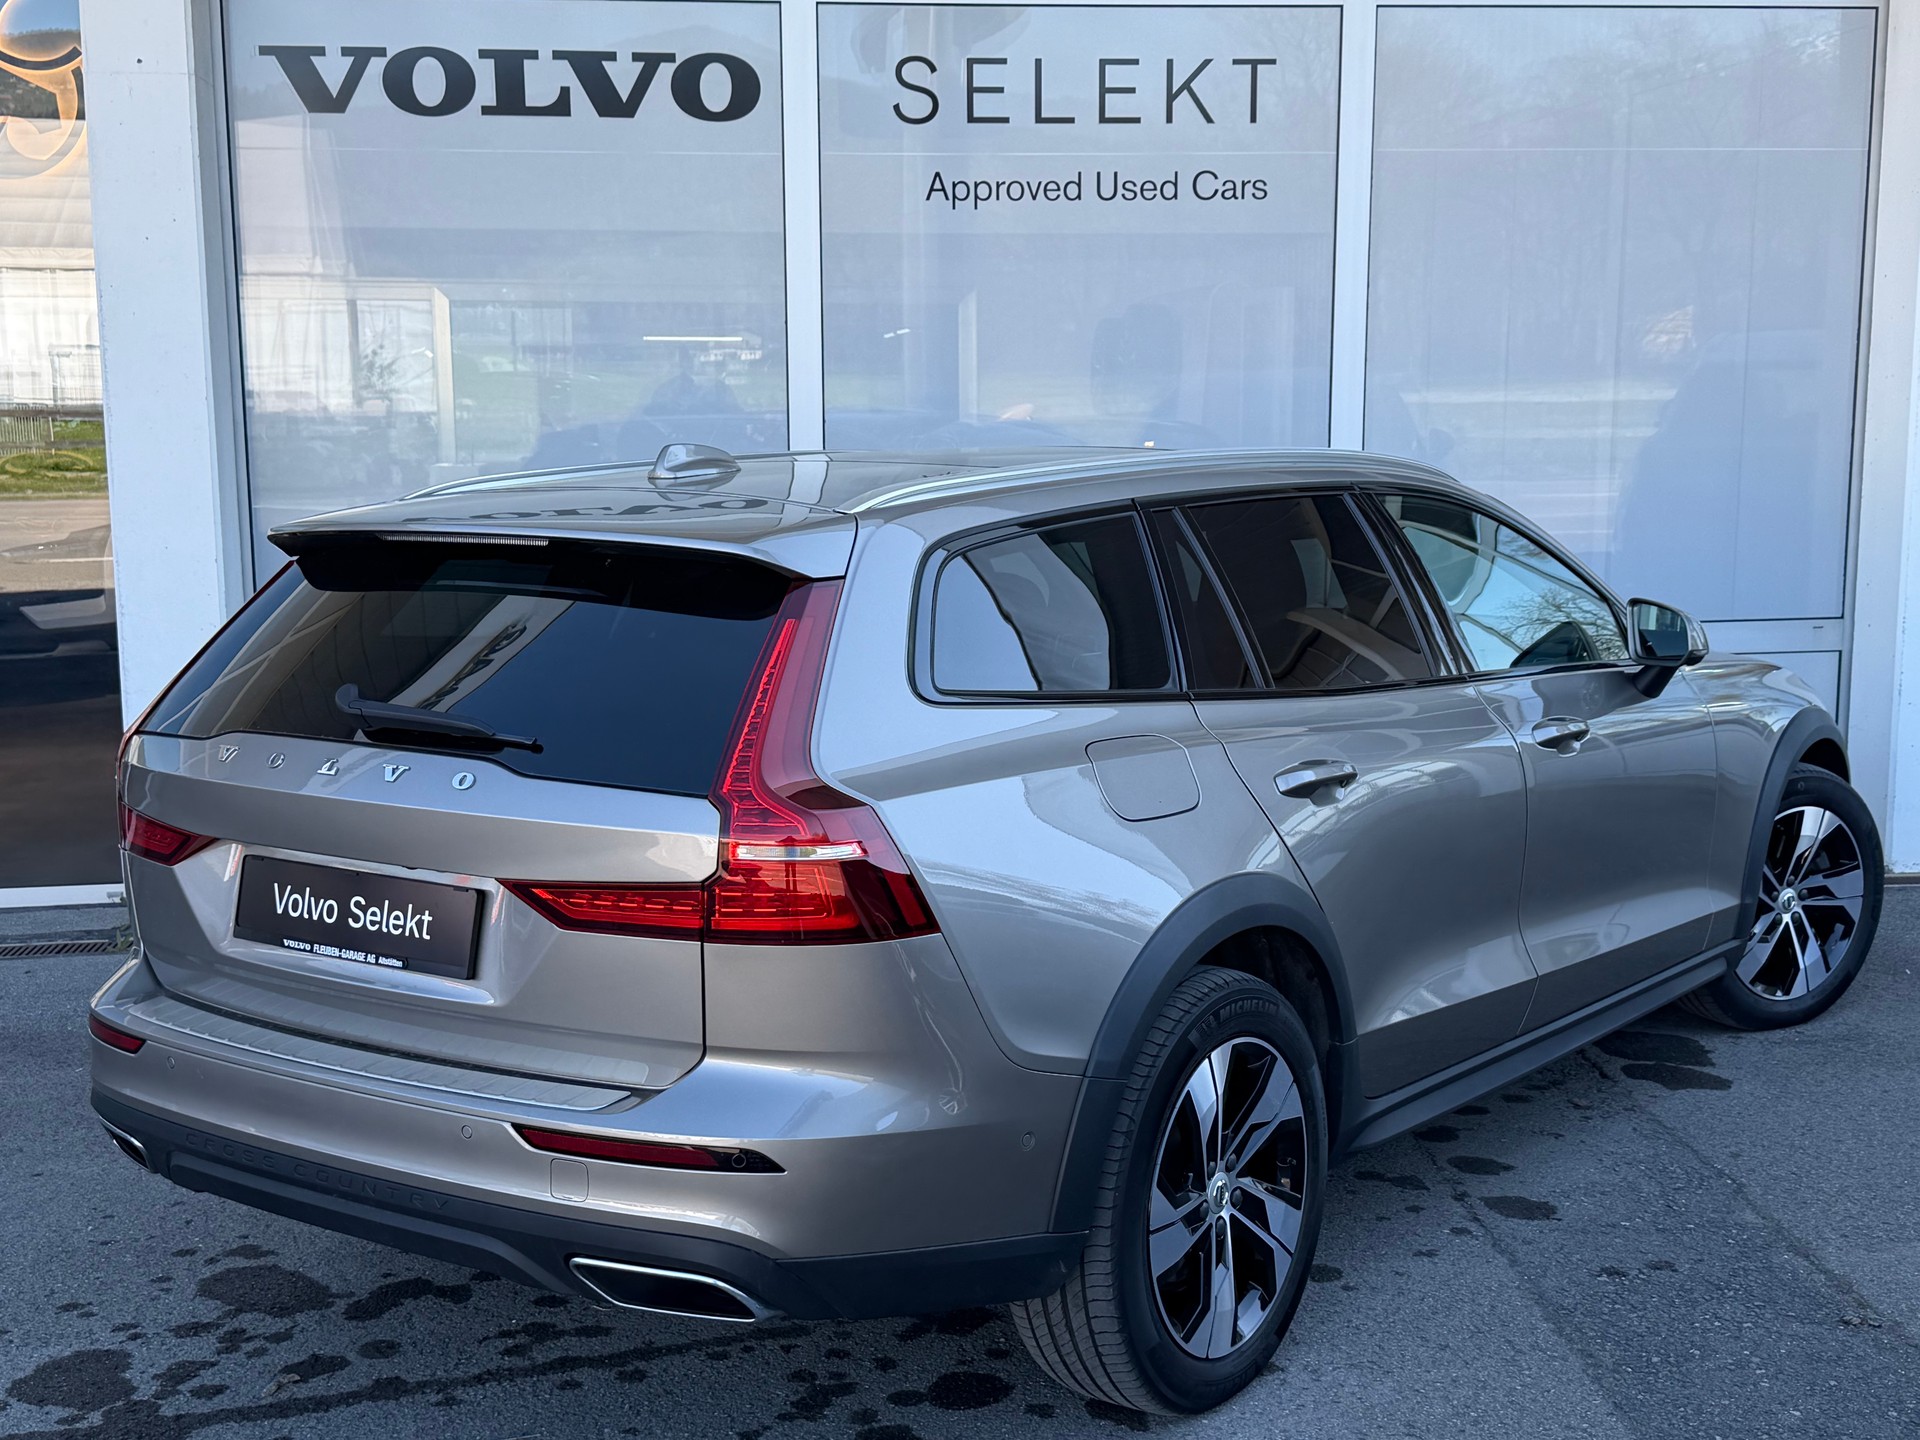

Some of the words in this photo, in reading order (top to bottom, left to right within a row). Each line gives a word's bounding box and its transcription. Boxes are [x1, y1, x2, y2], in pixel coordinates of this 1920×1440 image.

[259, 46, 761, 122] VOLVO
[893, 56, 1277, 124] SELEKT
[926, 171, 1082, 210] Approved
[1096, 171, 1179, 202] Used
[1192, 170, 1268, 201] Cars
[218, 744, 477, 791] VOLVO
[273, 882, 338, 924] Volvo
[348, 895, 433, 940] Selekt
[283, 938, 311, 951] VOLVO
[313, 943, 366, 962] FLEUBEN-GARAGE
[366, 953, 376, 964] AG
[1219, 998, 1279, 1023] MICHELIN
[185, 1131, 275, 1169] CROSS
[293, 1163, 450, 1210] COUNTRY
